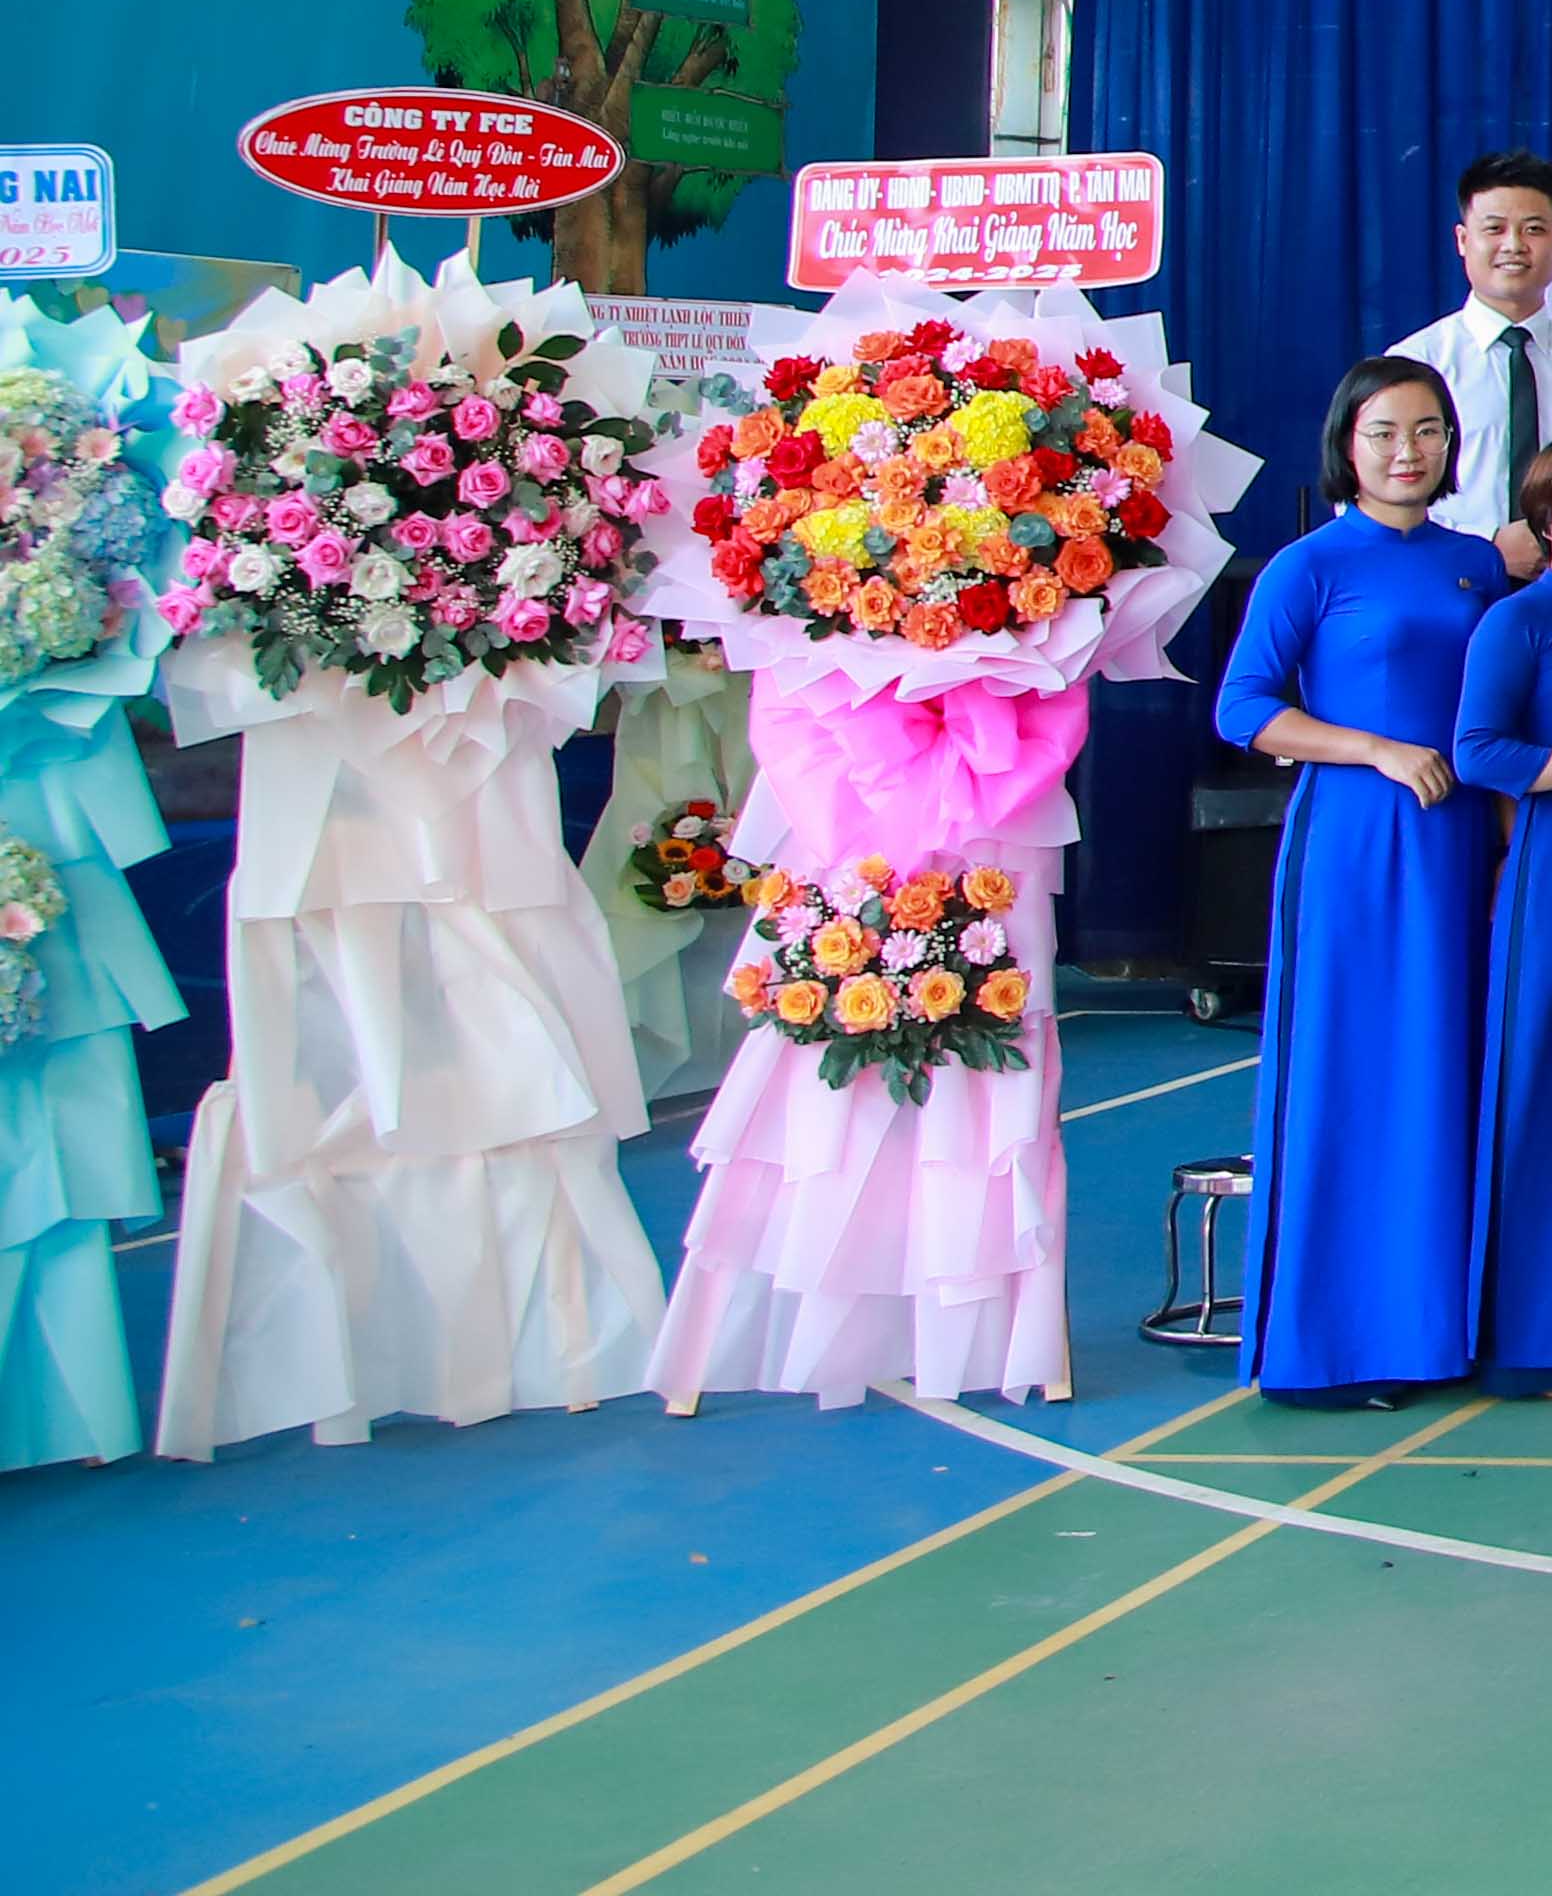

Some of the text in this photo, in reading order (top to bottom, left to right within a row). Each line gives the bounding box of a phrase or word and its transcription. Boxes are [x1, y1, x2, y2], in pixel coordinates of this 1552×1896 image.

[344, 102, 534, 135] CÔNG TY FCE
[576, 145, 611, 169] Mai
[34, 169, 97, 203] NAI
[325, 167, 371, 193] Khai
[427, 171, 470, 197] Năm
[472, 173, 507, 202] Học
[1117, 168, 1153, 203] MAI
[819, 217, 868, 259] Chúc
[933, 215, 981, 255] Khai
[984, 211, 1043, 263] Giảng
[1047, 212, 1097, 251] Năm
[1101, 210, 1138, 262] Học
